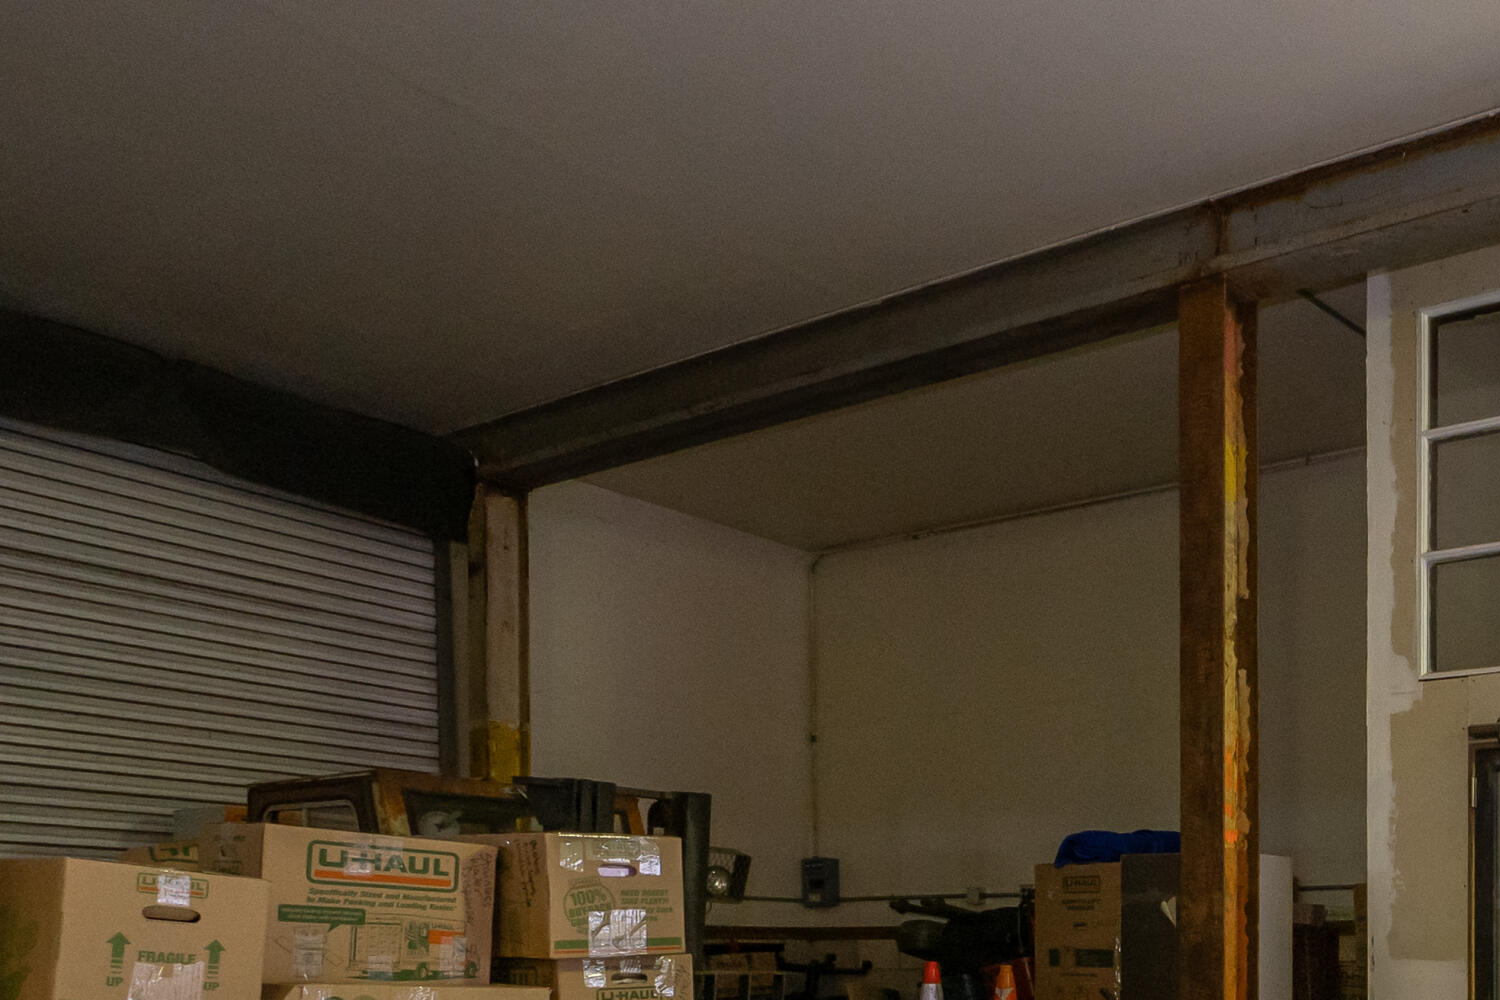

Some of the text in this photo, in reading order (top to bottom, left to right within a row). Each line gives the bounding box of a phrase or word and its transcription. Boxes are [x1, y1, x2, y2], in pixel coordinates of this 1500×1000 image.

[318, 847, 449, 877] U-HAUL
[138, 950, 197, 965] FRAGILE
[106, 976, 124, 987] UP
[203, 981, 221, 991] UP
[601, 989, 659, 1000] U-HAUL
